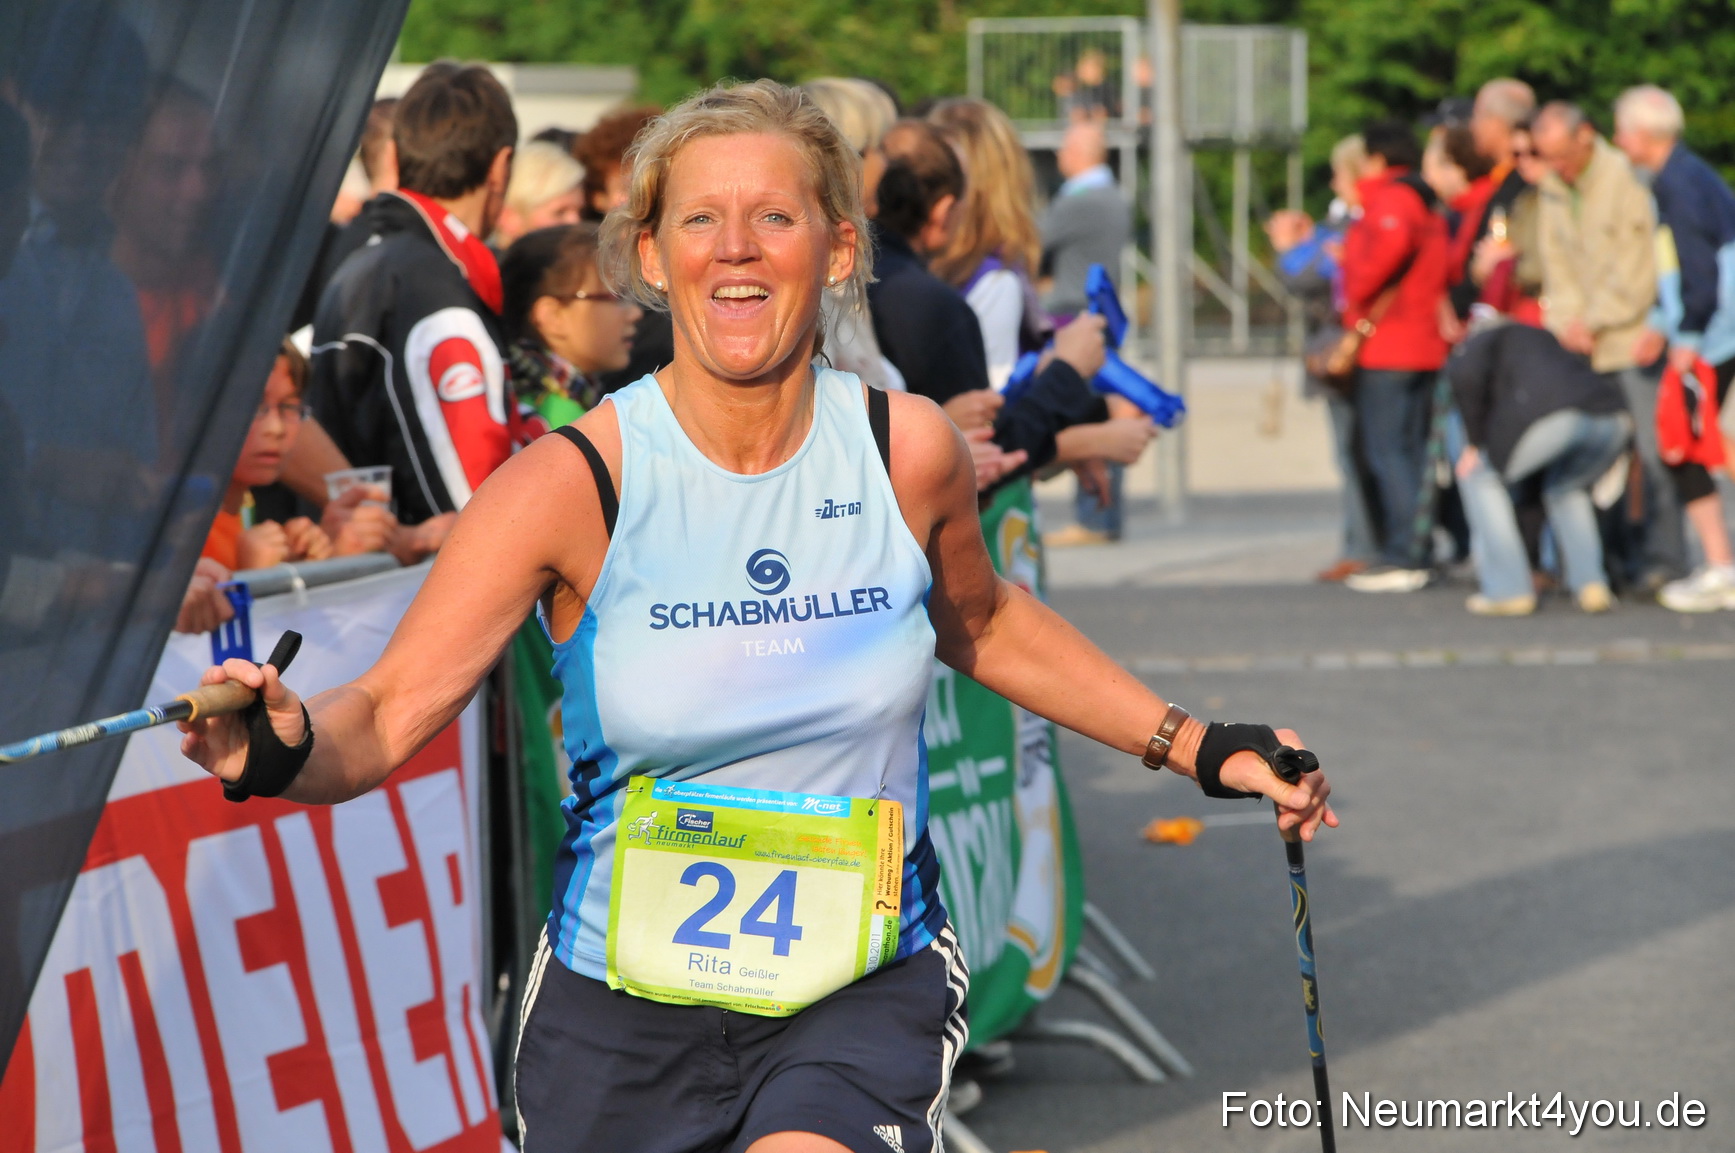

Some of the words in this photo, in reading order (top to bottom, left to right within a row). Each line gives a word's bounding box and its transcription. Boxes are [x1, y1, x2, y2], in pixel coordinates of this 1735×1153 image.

[649, 586, 893, 630] SCHABMÜLLER
[741, 637, 805, 658] TEAM
[656, 840, 695, 849] neumarkt
[657, 825, 748, 849] firmenlauf
[885, 868, 894, 896] Werbung
[672, 861, 803, 957] 24
[687, 952, 732, 975] Rita
[739, 966, 780, 981] Geißler
[689, 978, 714, 990] Team
[716, 981, 775, 997] Schabmüller
[873, 1125, 905, 1153] adidas
